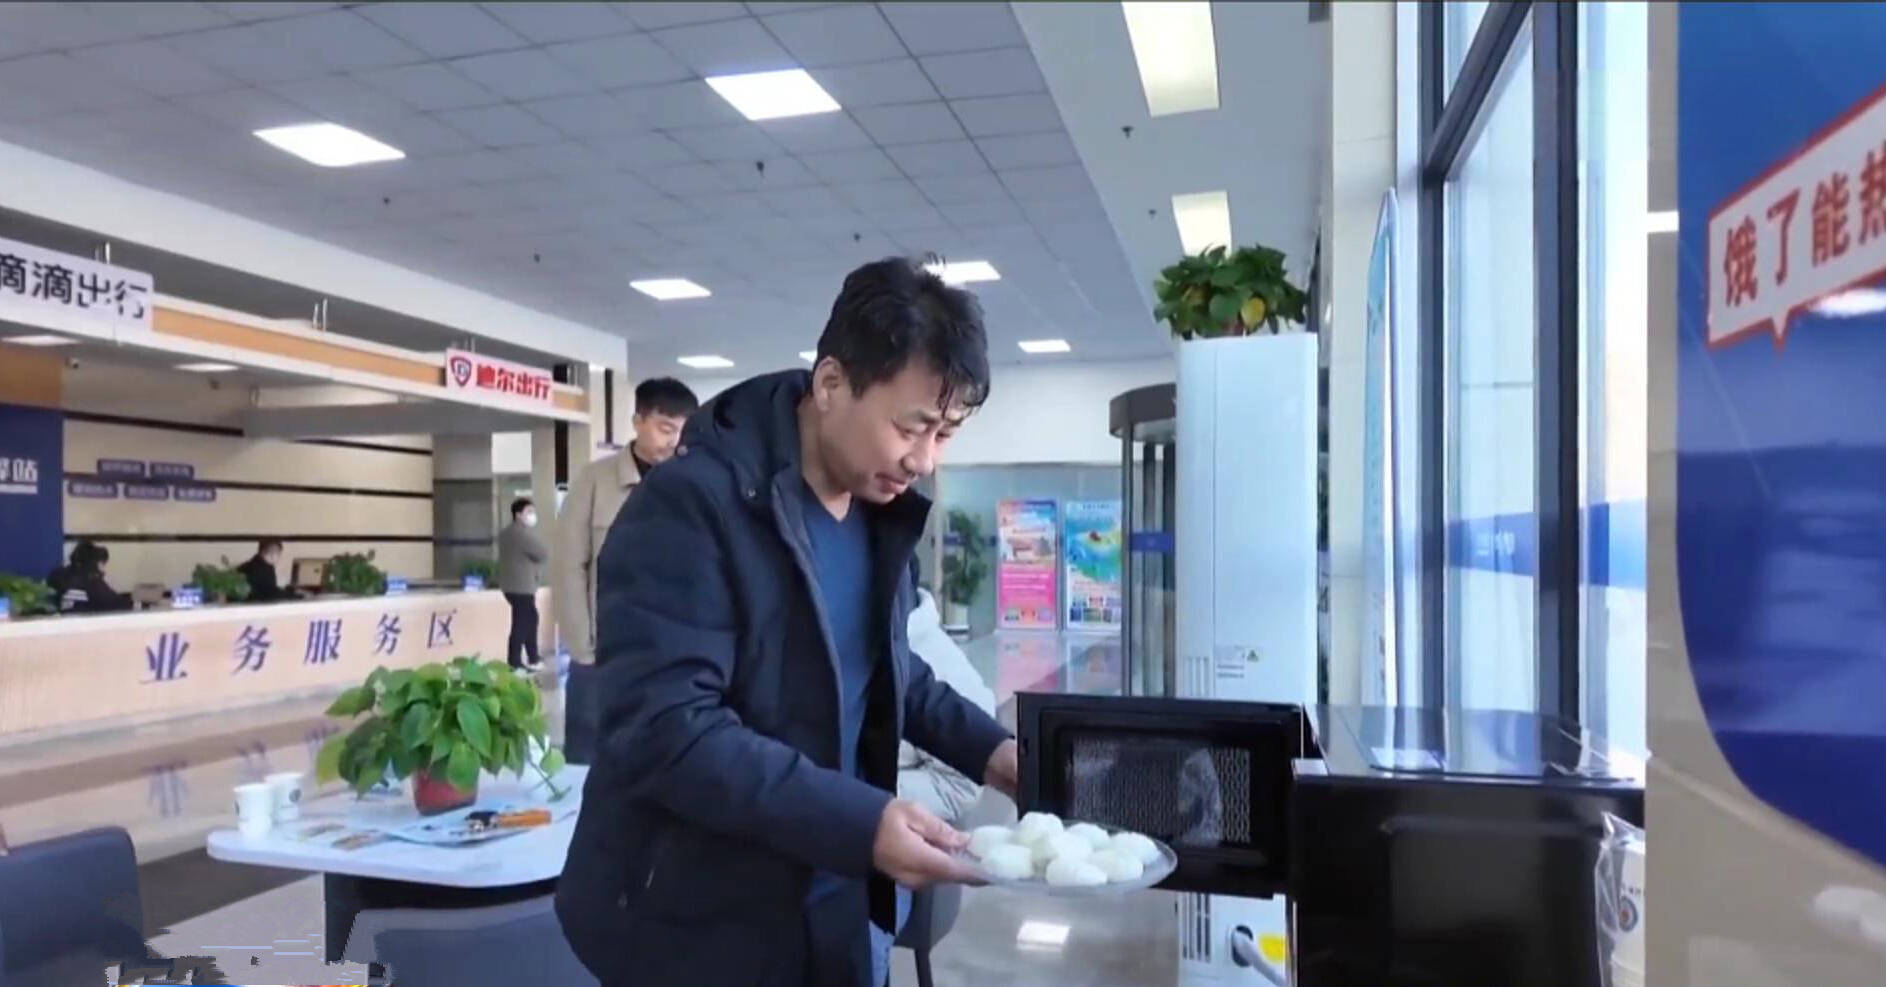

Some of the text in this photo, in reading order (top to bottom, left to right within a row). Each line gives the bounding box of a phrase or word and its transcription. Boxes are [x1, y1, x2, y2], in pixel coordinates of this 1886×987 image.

[0, 254, 147, 318] 滴滴出行
[140, 609, 457, 684] 业务服务区
